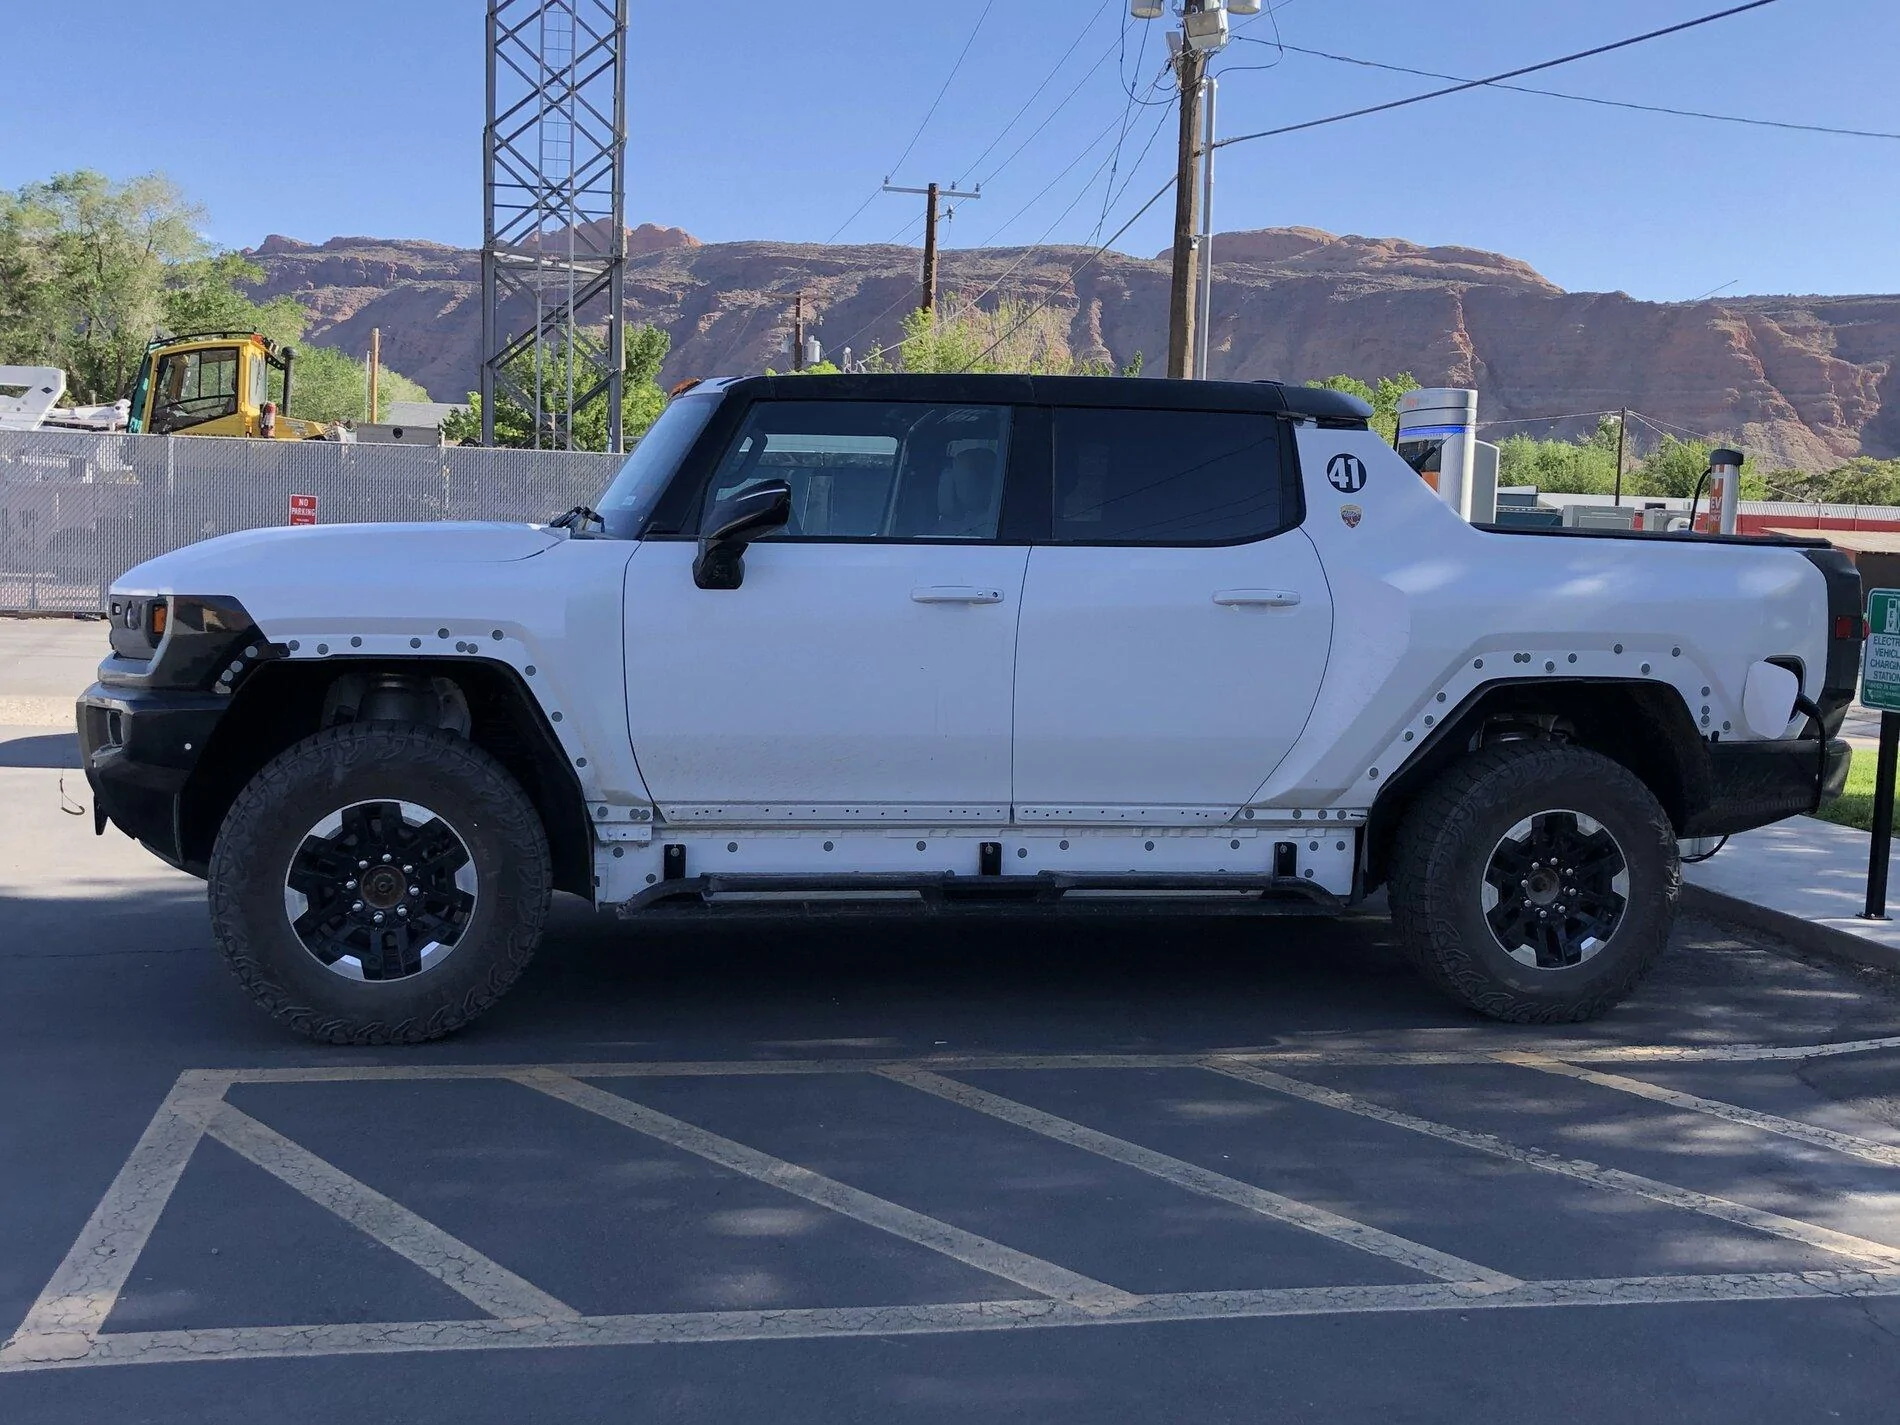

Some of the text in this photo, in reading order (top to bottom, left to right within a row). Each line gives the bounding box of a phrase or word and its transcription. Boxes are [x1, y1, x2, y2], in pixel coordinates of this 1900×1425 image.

[1328, 457, 1361, 489] 41
[298, 498, 309, 507] NO
[1711, 497, 1723, 510] EV
[291, 507, 316, 517] PARKING
